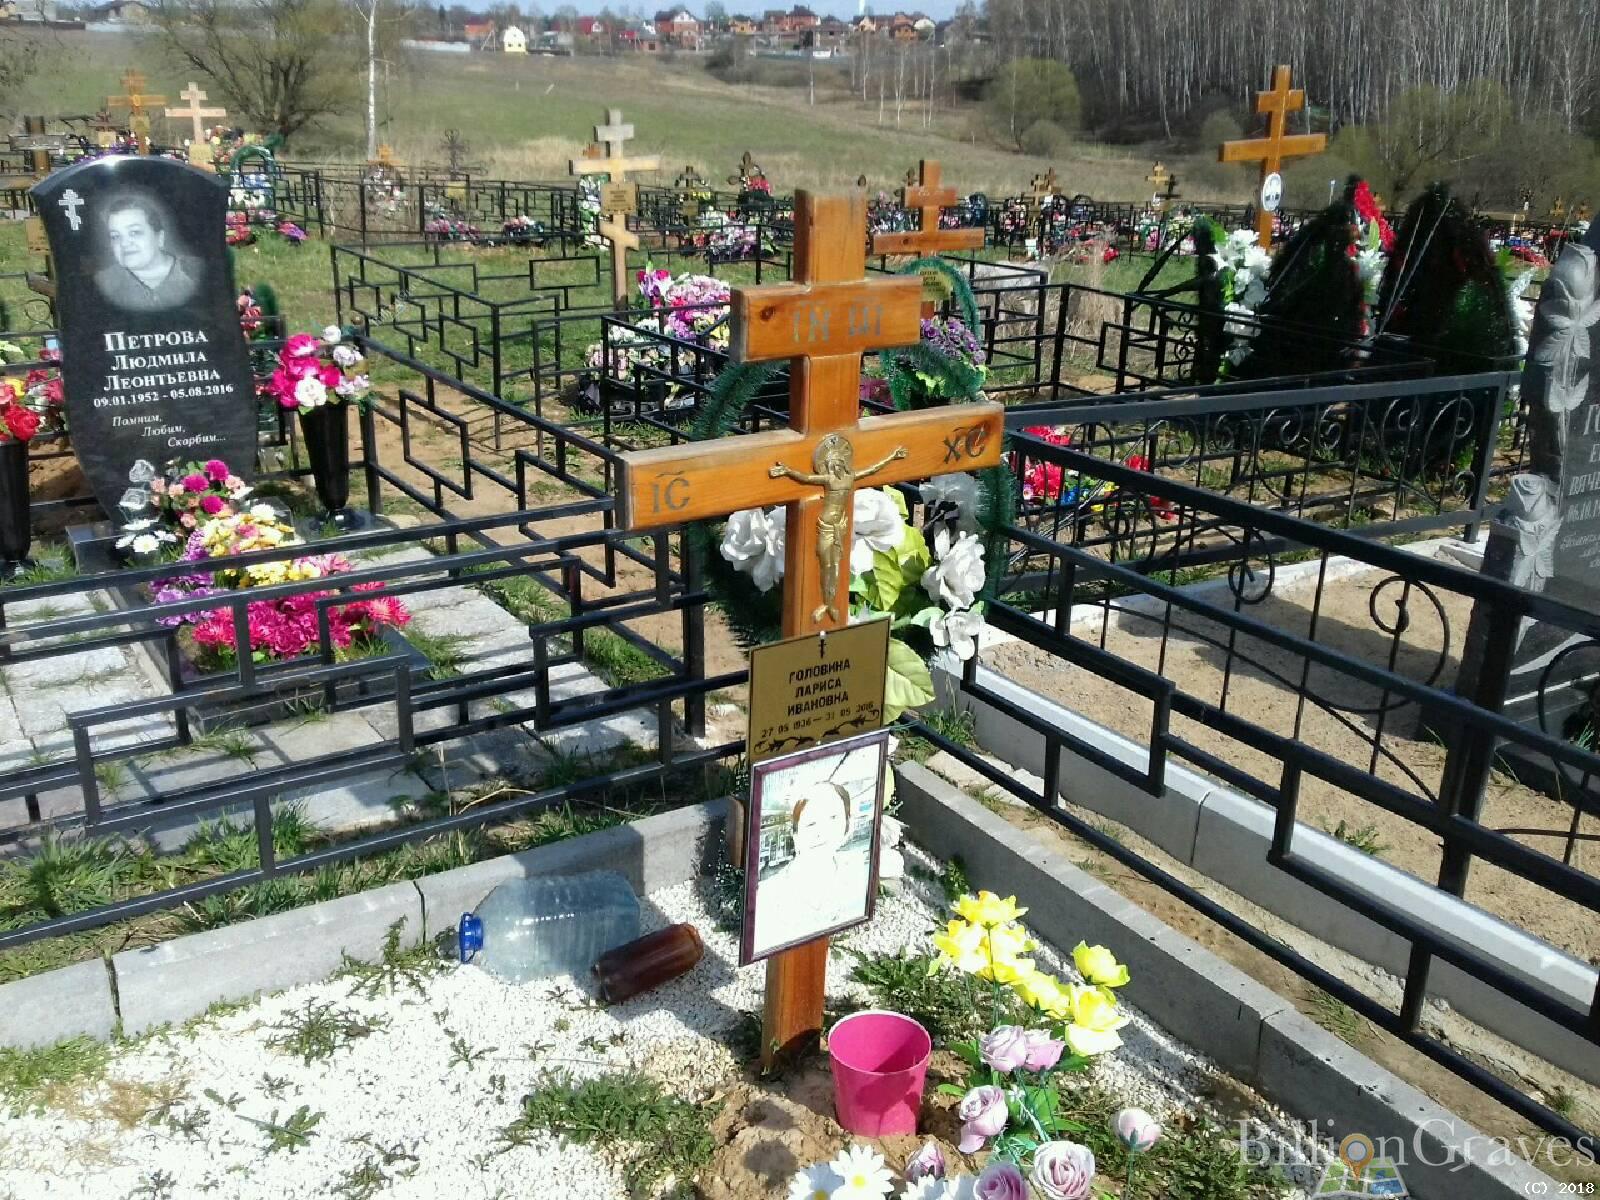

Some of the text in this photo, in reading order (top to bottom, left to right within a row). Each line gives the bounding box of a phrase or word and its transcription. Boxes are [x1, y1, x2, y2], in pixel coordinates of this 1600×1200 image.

[104, 331, 208, 351] ПЕТРОВА
[111, 351, 208, 371] ЛЮДМИЛА
[104, 369, 221, 391] ЛЕОНТЬЕВНА
[93, 391, 160, 408] 09.01.1952
[789, 658, 851, 684] ГОЛОВИНА
[795, 678, 842, 698] ЛАРИСА
[787, 691, 849, 717] ИВАНОВНА
